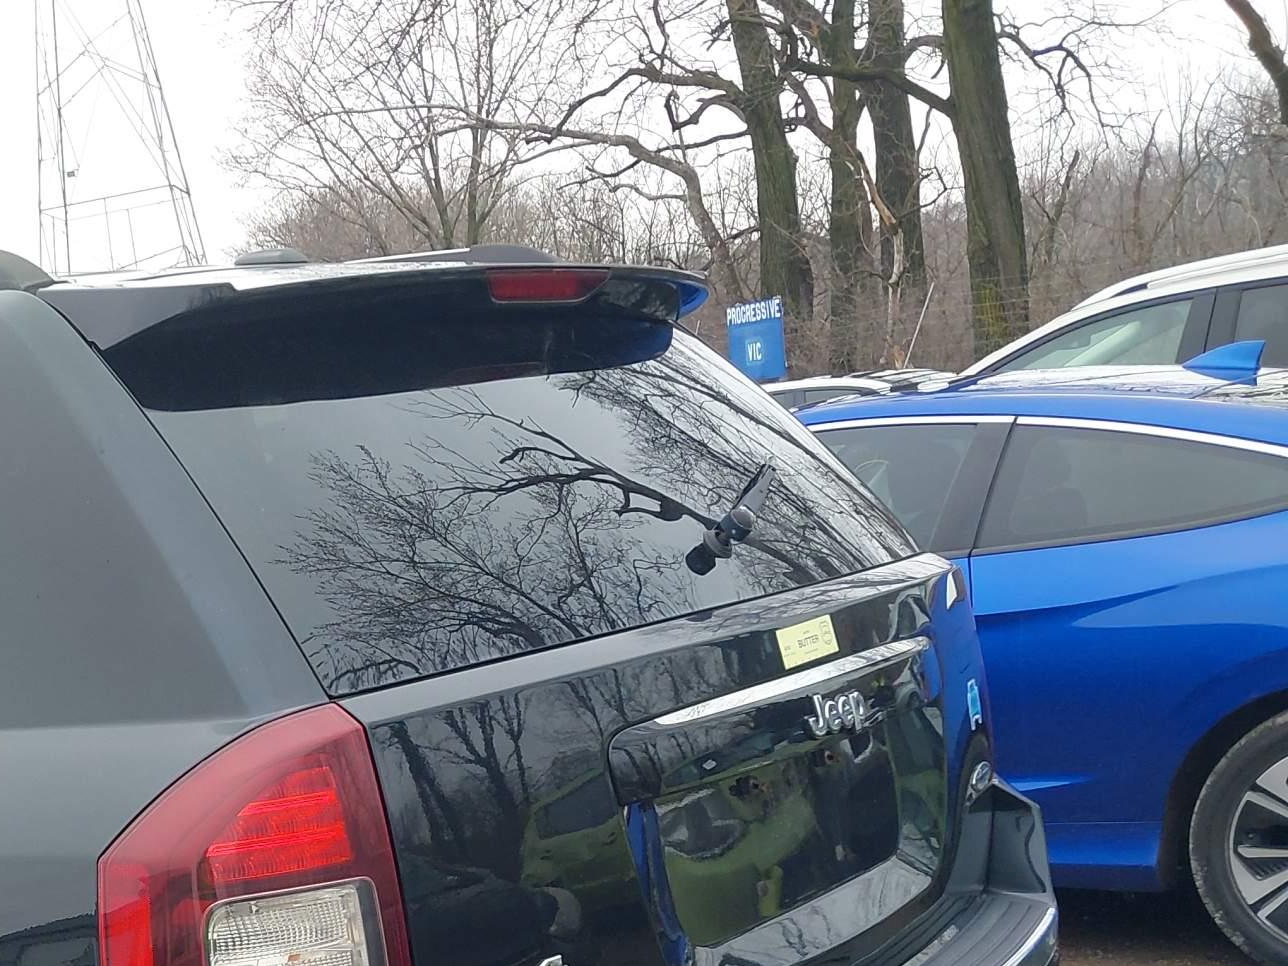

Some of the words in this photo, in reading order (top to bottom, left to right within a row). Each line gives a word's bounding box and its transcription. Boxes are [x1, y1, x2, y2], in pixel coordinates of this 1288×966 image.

[726, 299, 782, 326] PROGRESSIVE
[747, 342, 763, 361] VIC
[805, 691, 866, 736] Jeep
